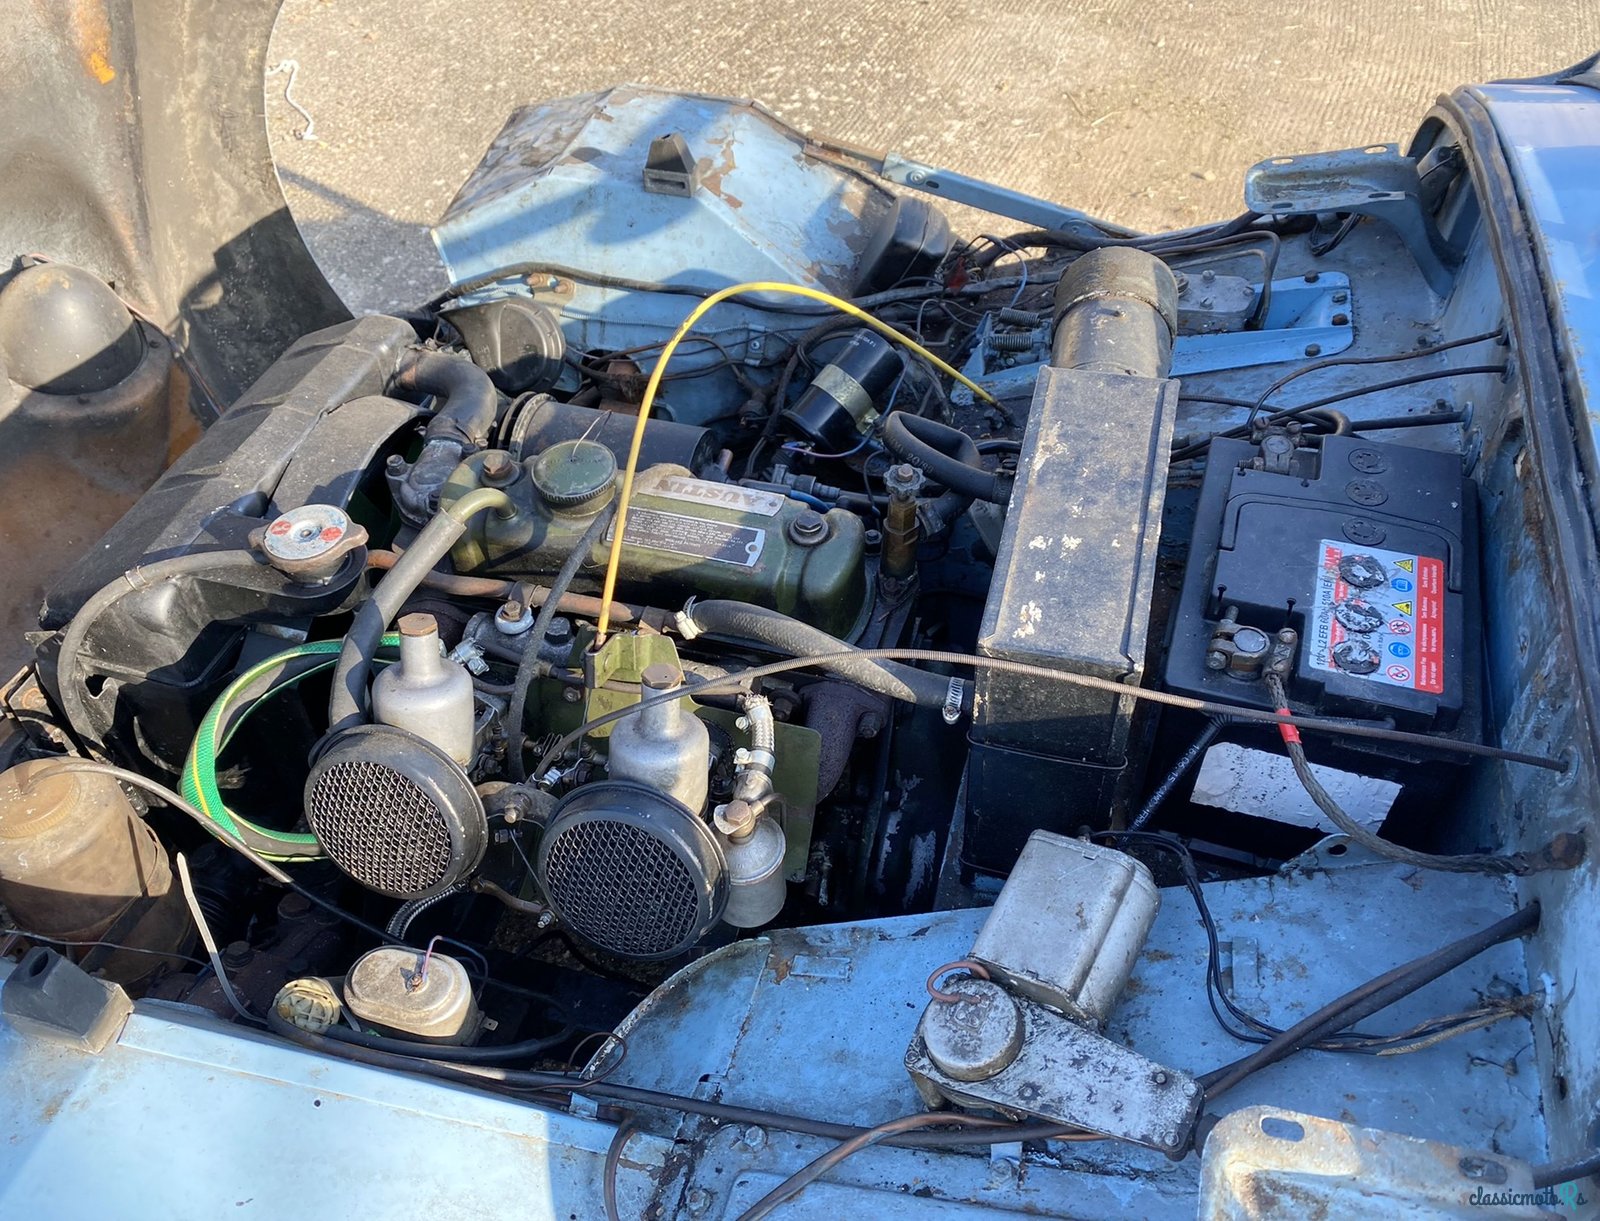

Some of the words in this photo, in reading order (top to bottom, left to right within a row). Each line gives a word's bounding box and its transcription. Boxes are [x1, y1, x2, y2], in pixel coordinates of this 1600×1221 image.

[652, 479, 764, 507] AUSTIN
[1322, 589, 1332, 606] 510A
[1319, 624, 1329, 638] EFB
